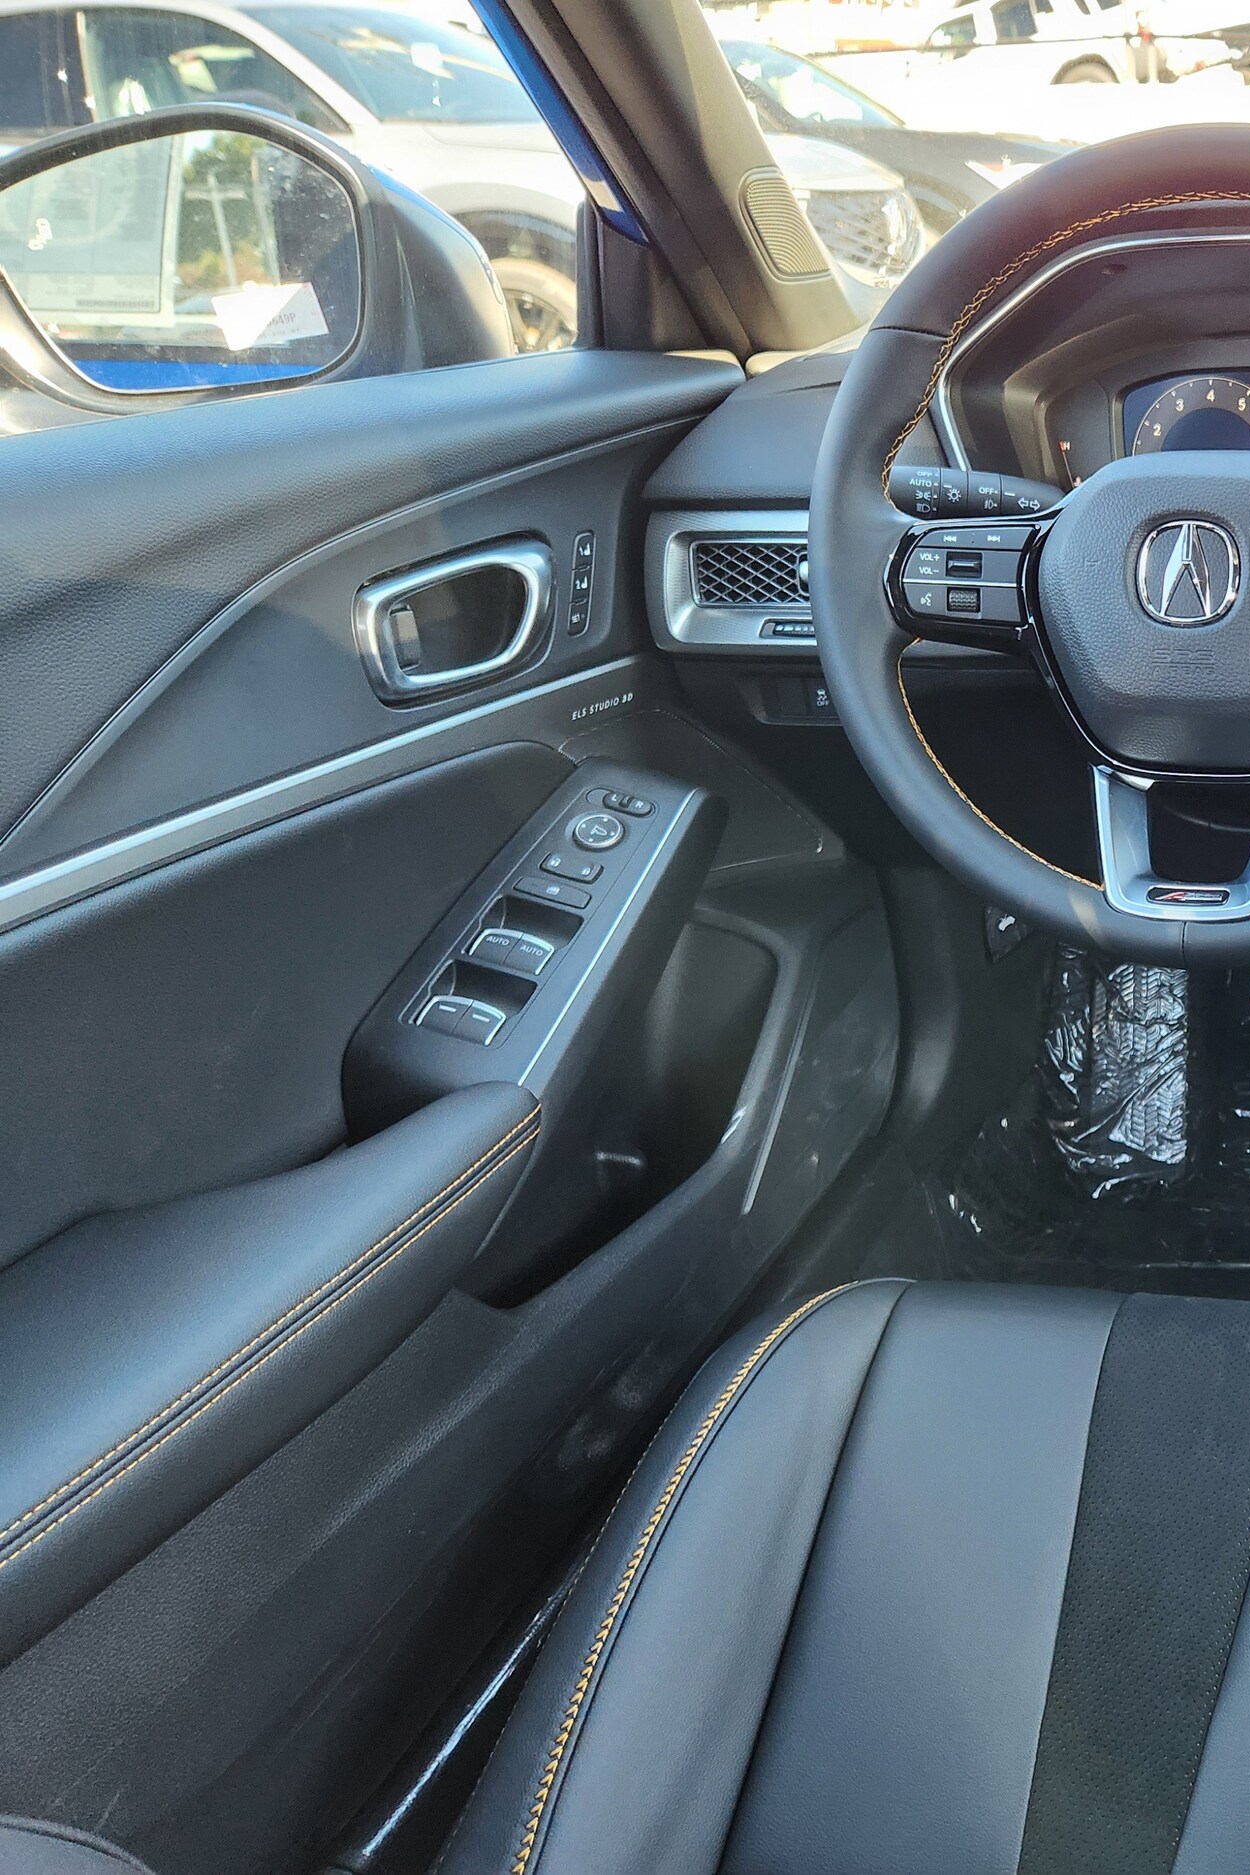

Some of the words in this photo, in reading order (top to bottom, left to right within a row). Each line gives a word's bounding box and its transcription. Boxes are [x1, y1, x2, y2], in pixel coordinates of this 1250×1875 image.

[1206, 389, 1215, 402] 4
[1175, 399, 1184, 412] 3
[1237, 398, 1246, 411] 5
[1153, 423, 1162, 436] 2
[910, 479, 932, 488] AUTO
[978, 487, 995, 495] OFF
[571, 707, 587, 721] ELS
[589, 697, 619, 715] STUDIO
[486, 935, 510, 947] AUTO
[520, 944, 543, 957] AUTO
